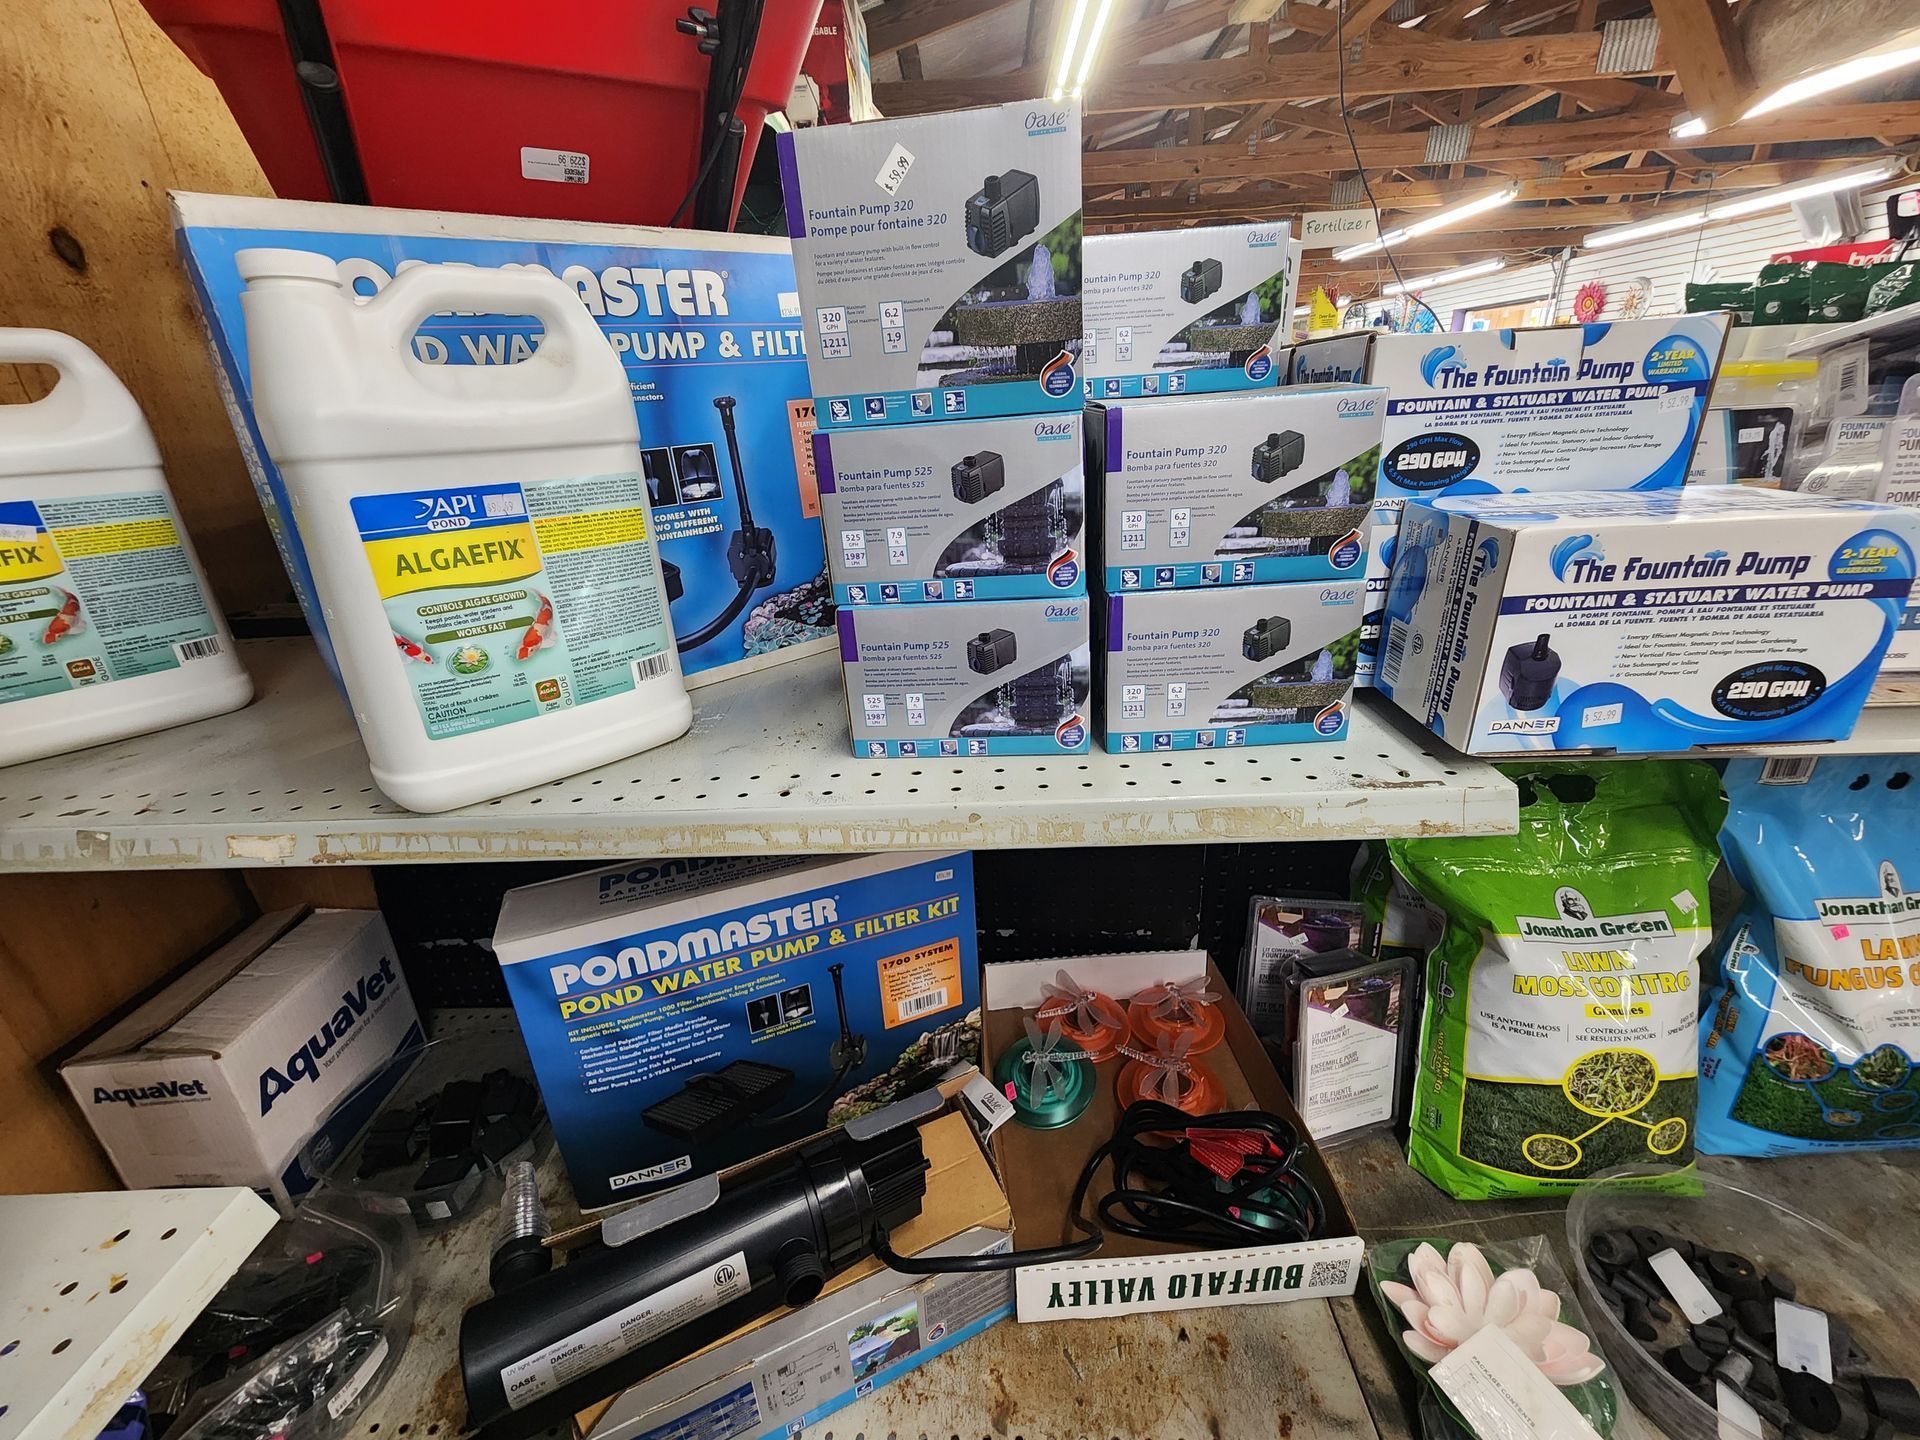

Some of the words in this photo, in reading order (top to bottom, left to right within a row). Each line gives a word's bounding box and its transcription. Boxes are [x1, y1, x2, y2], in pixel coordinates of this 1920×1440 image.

[1024, 110, 1066, 129] Oase
[808, 208, 857, 221] Fountain
[859, 203, 891, 218] Pump
[893, 199, 914, 212] 320
[810, 223, 848, 238] Pompe
[850, 221, 876, 235] pour
[877, 216, 924, 231] fontaine
[926, 213, 947, 226] 320
[1306, 220, 1372, 235] Fertilizer
[1247, 230, 1278, 243] Oase
[1083, 273, 1117, 285] ountain
[1119, 272, 1143, 283] Pump
[1145, 270, 1161, 280] 320
[822, 313, 841, 322] 320
[884, 307, 898, 318] 6.2
[616, 332, 705, 361] PUMP
[719, 331, 740, 357] &
[823, 338, 847, 348] 1211
[1650, 349, 1696, 361] 2-YEAR
[1441, 367, 1477, 390] The
[1484, 362, 1570, 386] Fountain
[1579, 358, 1634, 382] Pump
[1337, 398, 1374, 412] Oase
[1396, 396, 1471, 414] FOUNTAIN
[1475, 396, 1488, 409] &
[1491, 391, 1567, 409] STATUARY
[1572, 388, 1626, 403] WATER
[1625, 385, 1668, 399] PUMP
[1035, 422, 1071, 436] Oase
[1839, 431, 1870, 439] PUMP
[1840, 423, 1886, 431] FOUNTAIN
[1126, 448, 1172, 460] Fountain
[1175, 446, 1205, 460] Pump
[1207, 444, 1227, 455] 320
[1398, 453, 1432, 471] 290
[1434, 449, 1467, 468] GPH
[838, 470, 881, 481] Fountain
[883, 468, 912, 480] Pump
[914, 466, 933, 476] 525
[1126, 464, 1153, 472] Bomba
[1154, 463, 1172, 472] para
[1173, 461, 1201, 470] fuentes
[1203, 459, 1217, 467] 320
[840, 485, 864, 493] Bomba
[866, 483, 882, 492] para
[884, 481, 910, 490] fuentes
[912, 480, 925, 488] 525
[433, 495, 476, 517] API
[432, 518, 466, 529] POND
[655, 511, 685, 522] COMES
[688, 508, 710, 518] WITH
[674, 516, 718, 529] DIFFERENT
[845, 533, 861, 542] 525
[891, 531, 902, 540] 7.9
[396, 539, 524, 576] ALGAEFIX
[845, 552, 865, 561] 1987
[892, 550, 905, 559] 2.4
[1470, 554, 1488, 588] The
[1573, 558, 1621, 584] The
[1624, 555, 1728, 582] Fountain
[1737, 551, 1810, 579] Pump
[420, 601, 463, 615] CONTROLS
[465, 596, 491, 606] ALGAE
[492, 591, 525, 602] GROWTH
[1320, 588, 1354, 602] Oase
[1525, 594, 1615, 611] FOUNTAIN
[1622, 593, 1637, 606] &
[1643, 588, 1738, 605] STATUARY
[1742, 585, 1810, 601] WATER
[1815, 583, 1873, 598] PUMP
[425, 617, 443, 625] Keeps
[480, 607, 501, 616] gardens
[1044, 605, 1079, 618] Oase
[457, 626, 486, 637] WORKS
[488, 622, 507, 631] FAST
[1127, 632, 1169, 641] Fountain
[1172, 630, 1199, 641] Pump
[1201, 629, 1220, 637] 320
[1452, 592, 1478, 662] Fountain
[861, 643, 902, 652] Fountain
[903, 642, 930, 652] Pump
[932, 641, 950, 649] 525
[1632, 661, 1670, 669] Submerged
[559, 675, 572, 705] GUIDE
[1440, 667, 1461, 712] Pump
[1727, 682, 1766, 699] 290
[1768, 680, 1811, 698] GPH
[428, 707, 466, 720] CAUTION
[1585, 712, 1590, 722] $
[1593, 710, 1616, 722] 52.99
[1491, 719, 1556, 731] DANNER
[1820, 899, 1904, 917] Jonathan
[1523, 922, 1598, 938] Jonathan
[1600, 919, 1669, 936] Green
[550, 899, 838, 995] PONDMASTER
[561, 985, 643, 1019] POND
[651, 960, 742, 994] WATER
[751, 937, 819, 965] PUMP
[829, 929, 846, 945] &
[855, 909, 919, 938] FILTER
[928, 897, 959, 918] KIT
[883, 957, 911, 970] 1700
[915, 944, 953, 960] SYSTEM
[1562, 949, 1637, 972] LAWN
[1785, 957, 1904, 991] FUNGUS
[1513, 974, 1586, 997] MOSS
[580, 1022, 615, 1033] INCLUDES:
[617, 1010, 656, 1024] Pondmaster
[659, 1004, 675, 1012] 1000
[677, 999, 693, 1008] Filter,
[1480, 1011, 1495, 1021] USE
[1496, 1016, 1536, 1030] ANYTIME
[1538, 1023, 1561, 1032] MOSS
[260, 956, 397, 1118] AquaVet
[1312, 1034, 1340, 1046] FOUNTAIN
[1342, 1029, 1350, 1038] KIT
[1321, 1025, 1346, 1037] CONTAINER
[1491, 1021, 1499, 1029] IS
[1508, 1026, 1549, 1038] PROBLEM
[1575, 1034, 1588, 1042] SEE
[1590, 1034, 1622, 1042] RESULTS
[1633, 1033, 1657, 1042] HOURS
[1585, 1026, 1629, 1035] CONTROLS
[1630, 1026, 1650, 1034] MOSS,
[93, 1079, 208, 1107] AquaVet
[612, 1157, 688, 1189] DANNER
[1168, 1264, 1306, 1299] BUFFALO
[1047, 1277, 1155, 1309] VALLEY
[620, 1309, 654, 1330] DANGER:
[550, 1344, 587, 1364] DANGER:
[510, 1375, 537, 1392] OASE
[1472, 1355, 1501, 1388] PACKAGE
[1501, 1388, 1536, 1428] CONTENTS
